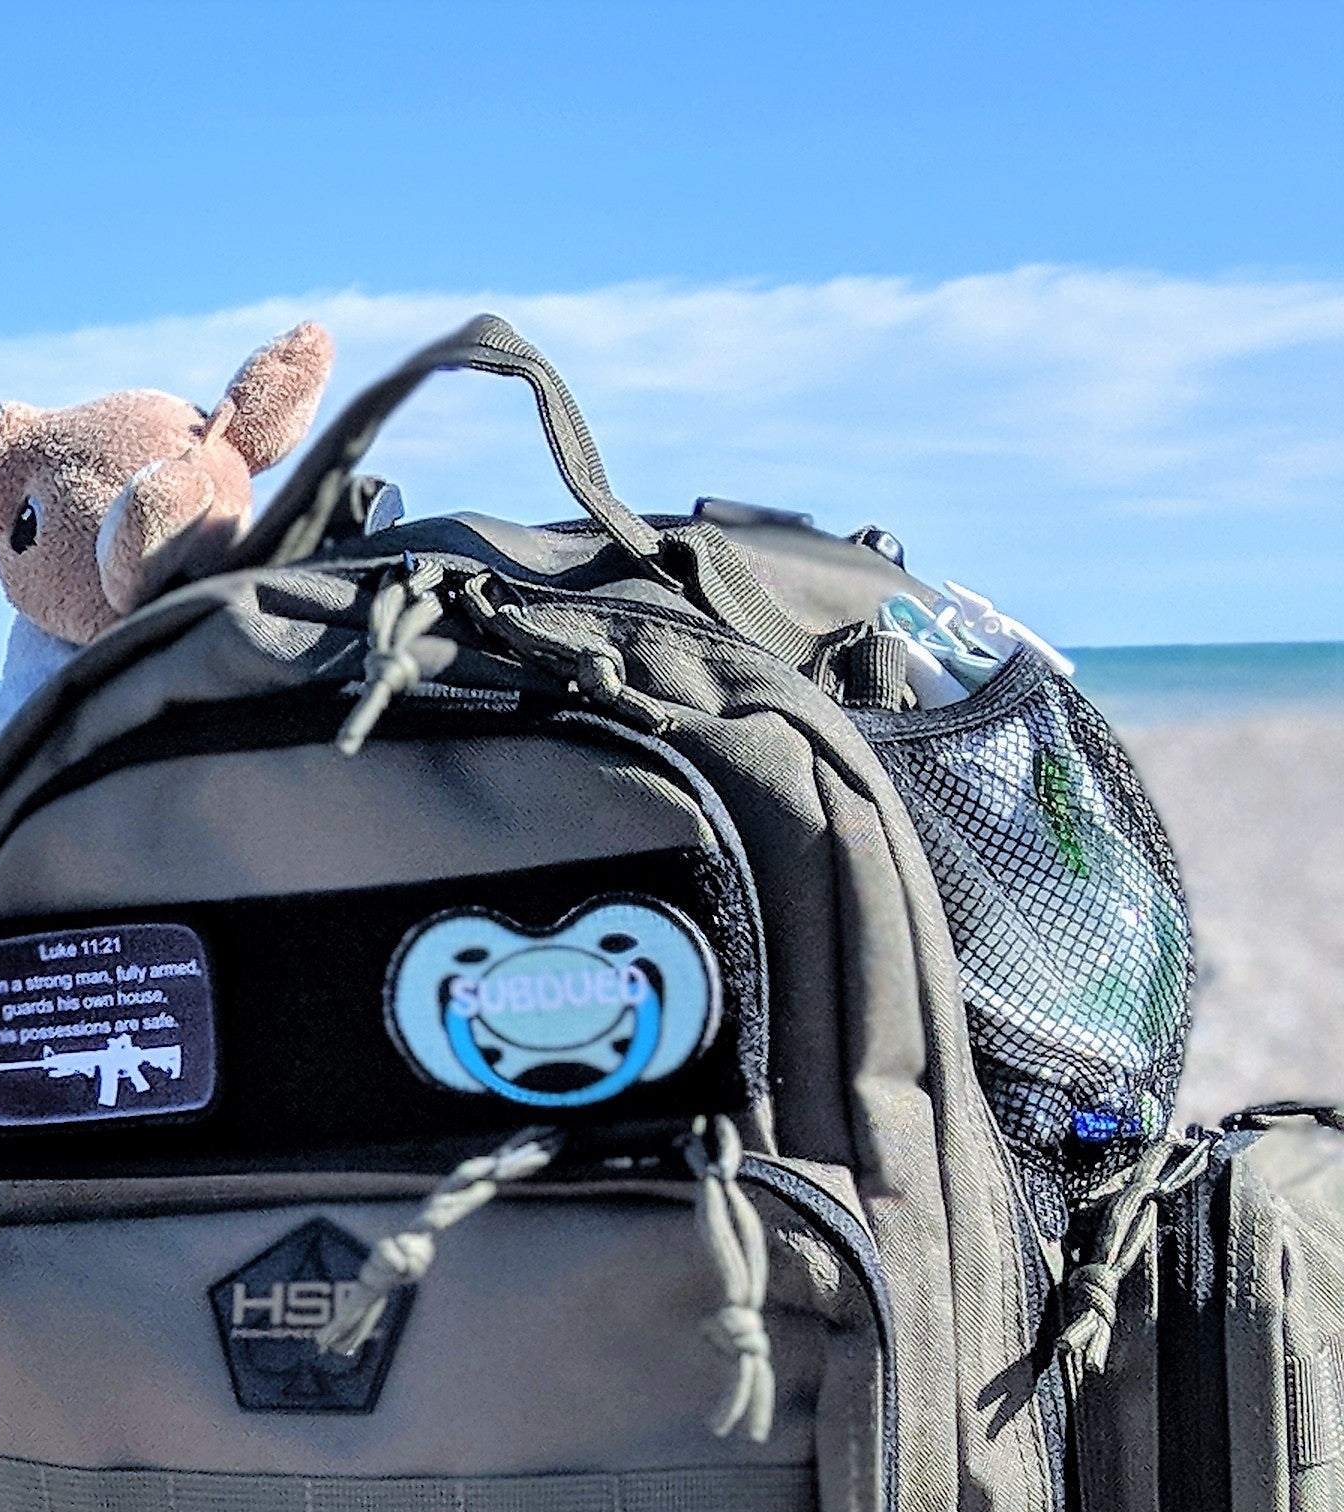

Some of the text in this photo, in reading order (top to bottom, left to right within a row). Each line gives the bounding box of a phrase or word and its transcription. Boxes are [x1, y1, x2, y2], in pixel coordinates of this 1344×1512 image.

[39, 936, 122, 962] Luke 11:21
[11, 979, 23, 992] a
[25, 974, 73, 991] strong
[76, 970, 114, 986] man,
[116, 964, 147, 984] fully
[149, 960, 202, 978] armed,
[450, 965, 648, 1018] SUBDUED
[2, 1000, 55, 1022] guards
[57, 996, 80, 1013] his
[82, 996, 114, 1010] own
[20, 1021, 112, 1045] possessions
[114, 1018, 140, 1034] are
[142, 1011, 180, 1032] safe.
